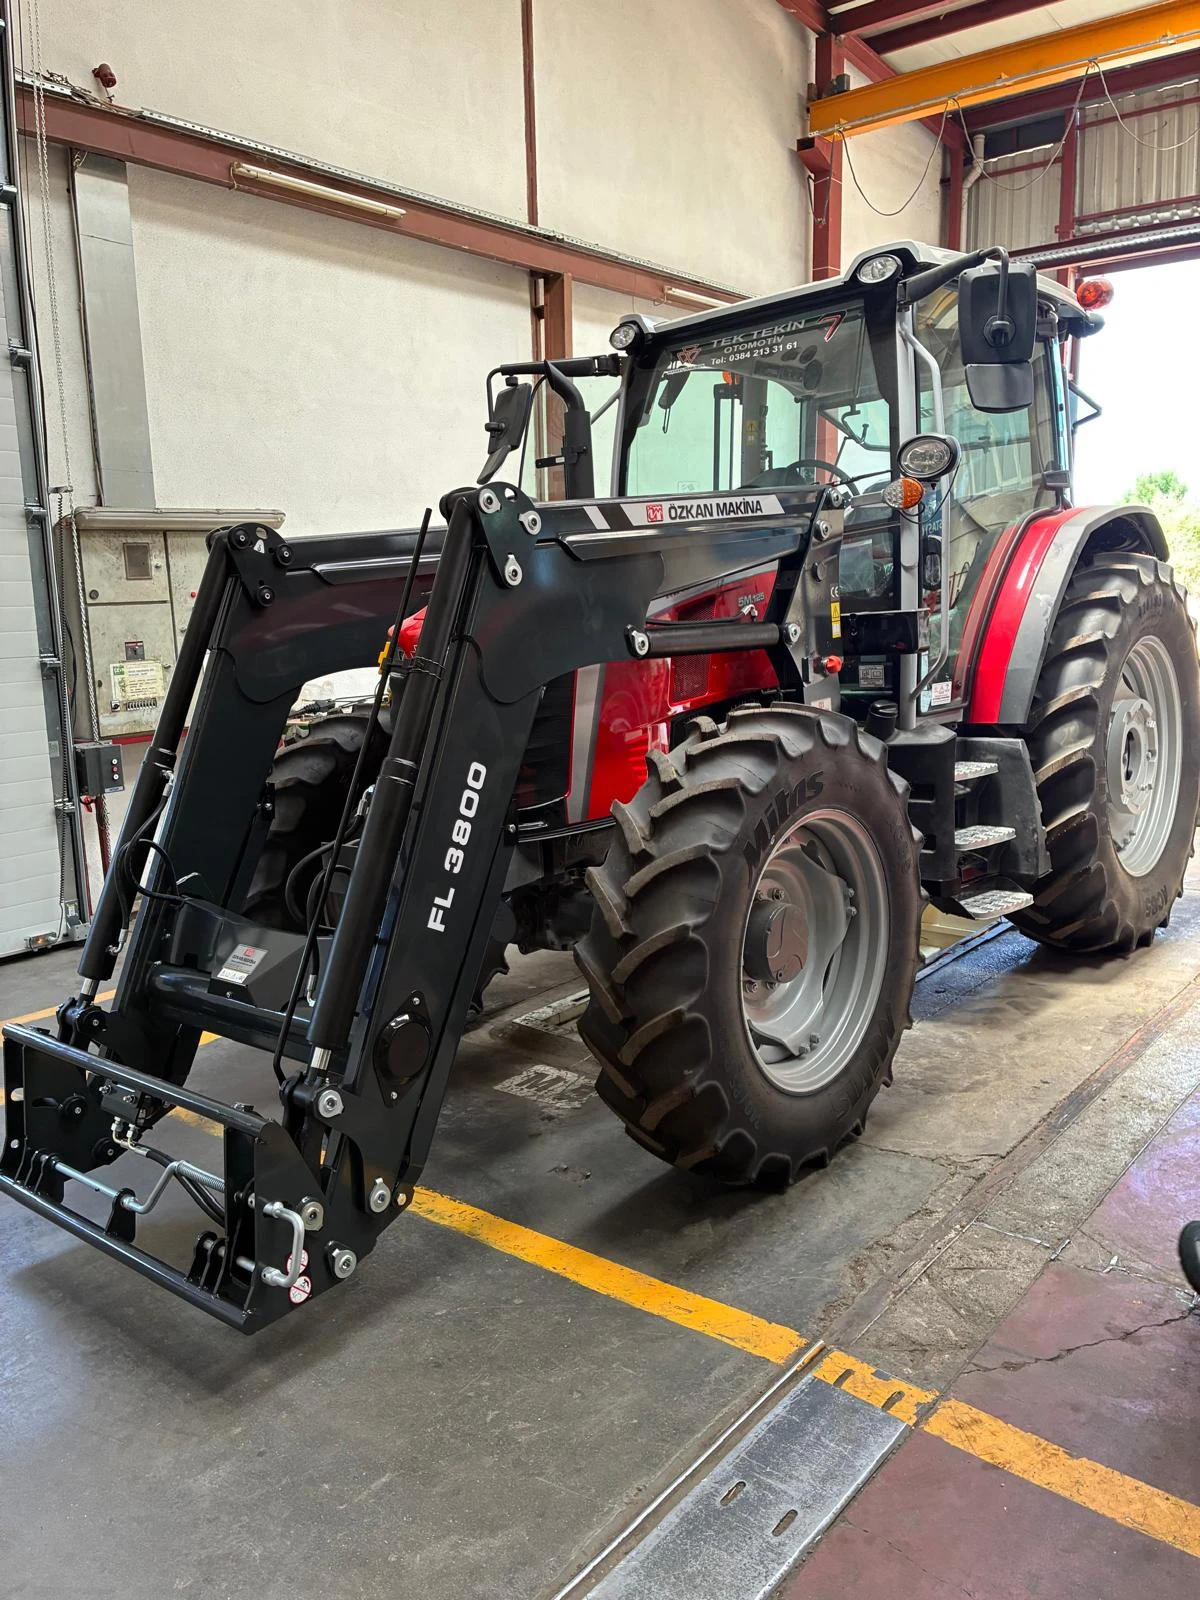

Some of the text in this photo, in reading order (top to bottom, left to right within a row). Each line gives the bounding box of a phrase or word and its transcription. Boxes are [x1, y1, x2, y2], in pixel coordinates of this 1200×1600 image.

[711, 320, 806, 348] TEK TEKİN
[724, 335, 785, 354] OTOMOTİV
[711, 341, 798, 365] Tel: 0384 213 31 61
[668, 503, 713, 520] ÖZKAN
[716, 498, 763, 517] MAKİNA
[427, 761, 487, 932] FL 3800
